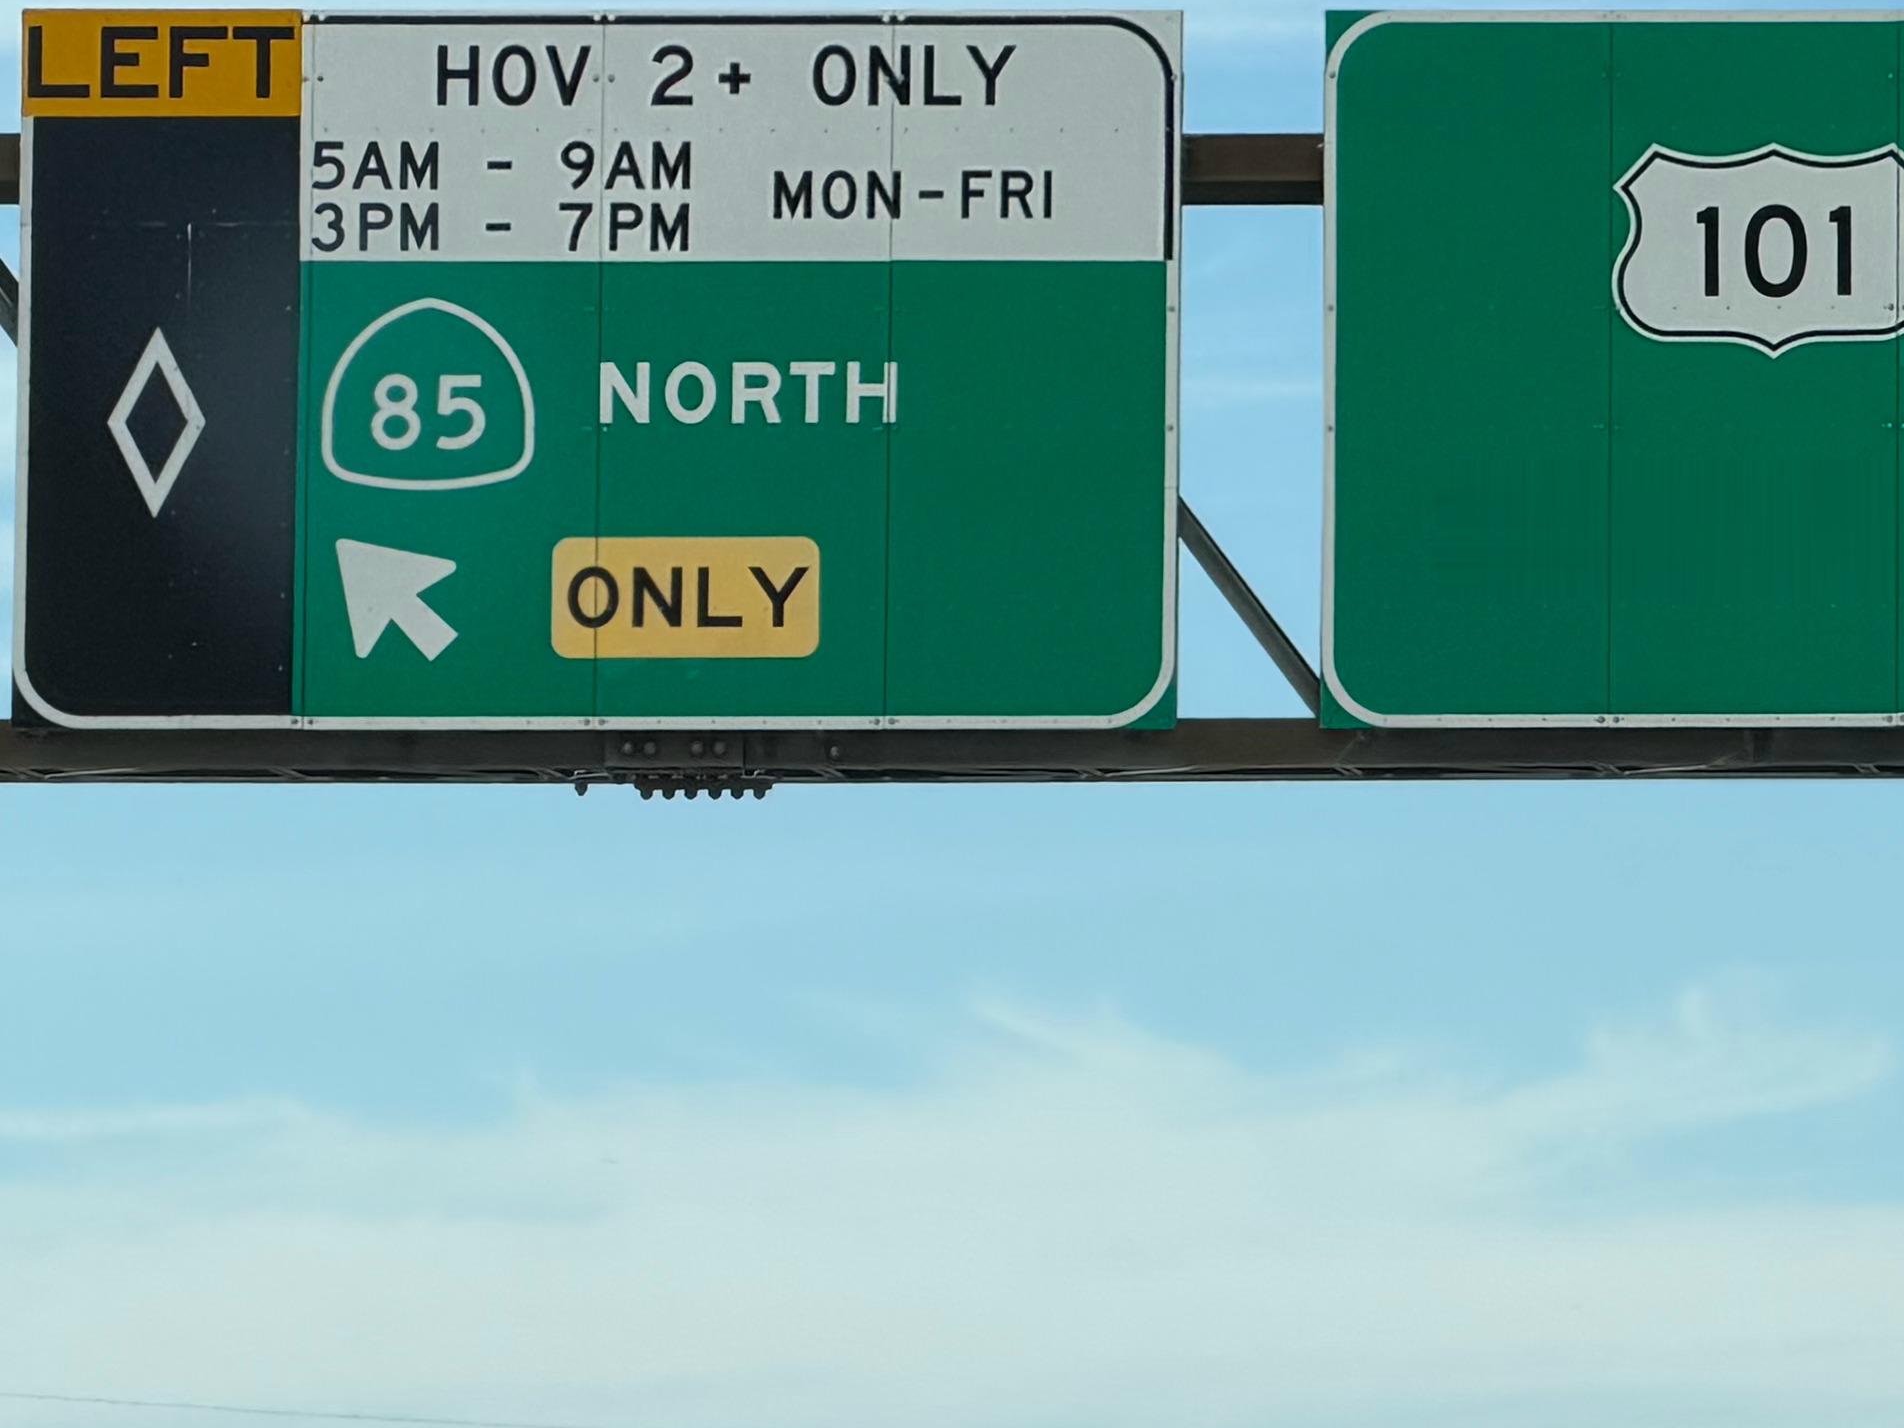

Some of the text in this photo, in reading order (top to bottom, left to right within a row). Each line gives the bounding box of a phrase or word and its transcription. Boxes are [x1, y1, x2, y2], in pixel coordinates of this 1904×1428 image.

[28, 25, 295, 99] LEFT
[437, 44, 592, 107] HOV
[812, 44, 1017, 107] ONLY
[311, 140, 440, 191] 5AM
[560, 140, 692, 190] 9AM
[772, 169, 1054, 220] MON-FRI
[311, 202, 440, 253] 3PM
[559, 202, 690, 252] 7PM
[1696, 203, 1853, 298] 101
[370, 361, 899, 451] 85 NORTH
[567, 565, 810, 630] ONLY
